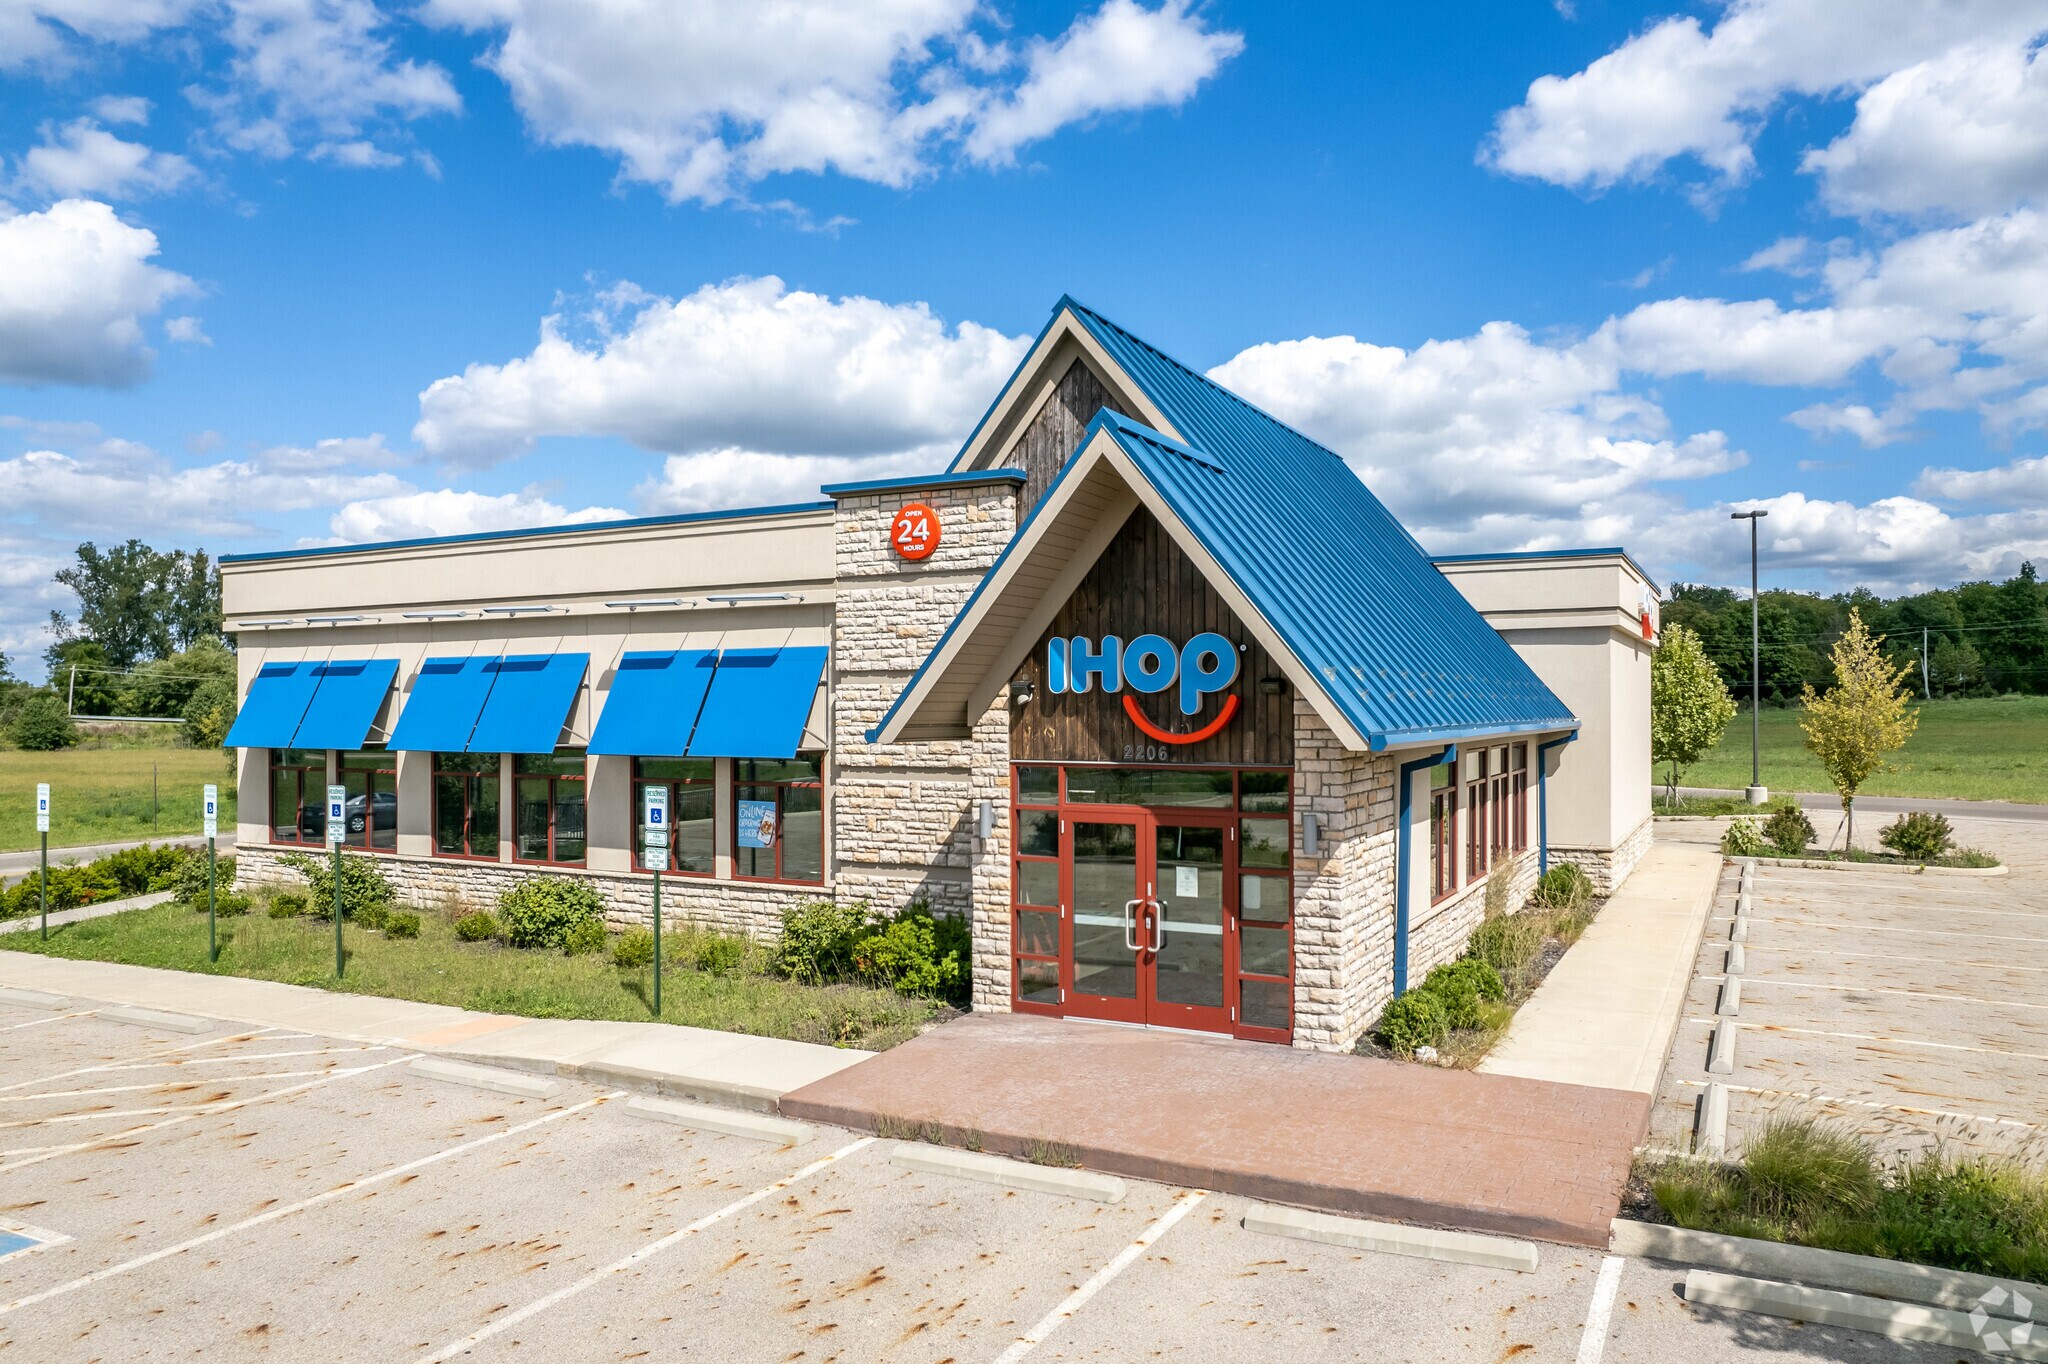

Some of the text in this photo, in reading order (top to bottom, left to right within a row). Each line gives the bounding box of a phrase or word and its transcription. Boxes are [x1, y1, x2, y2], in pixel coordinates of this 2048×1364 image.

[898, 518, 930, 544] 24
[1123, 744, 1168, 761] 2206
[740, 804, 766, 818] ONLINE
